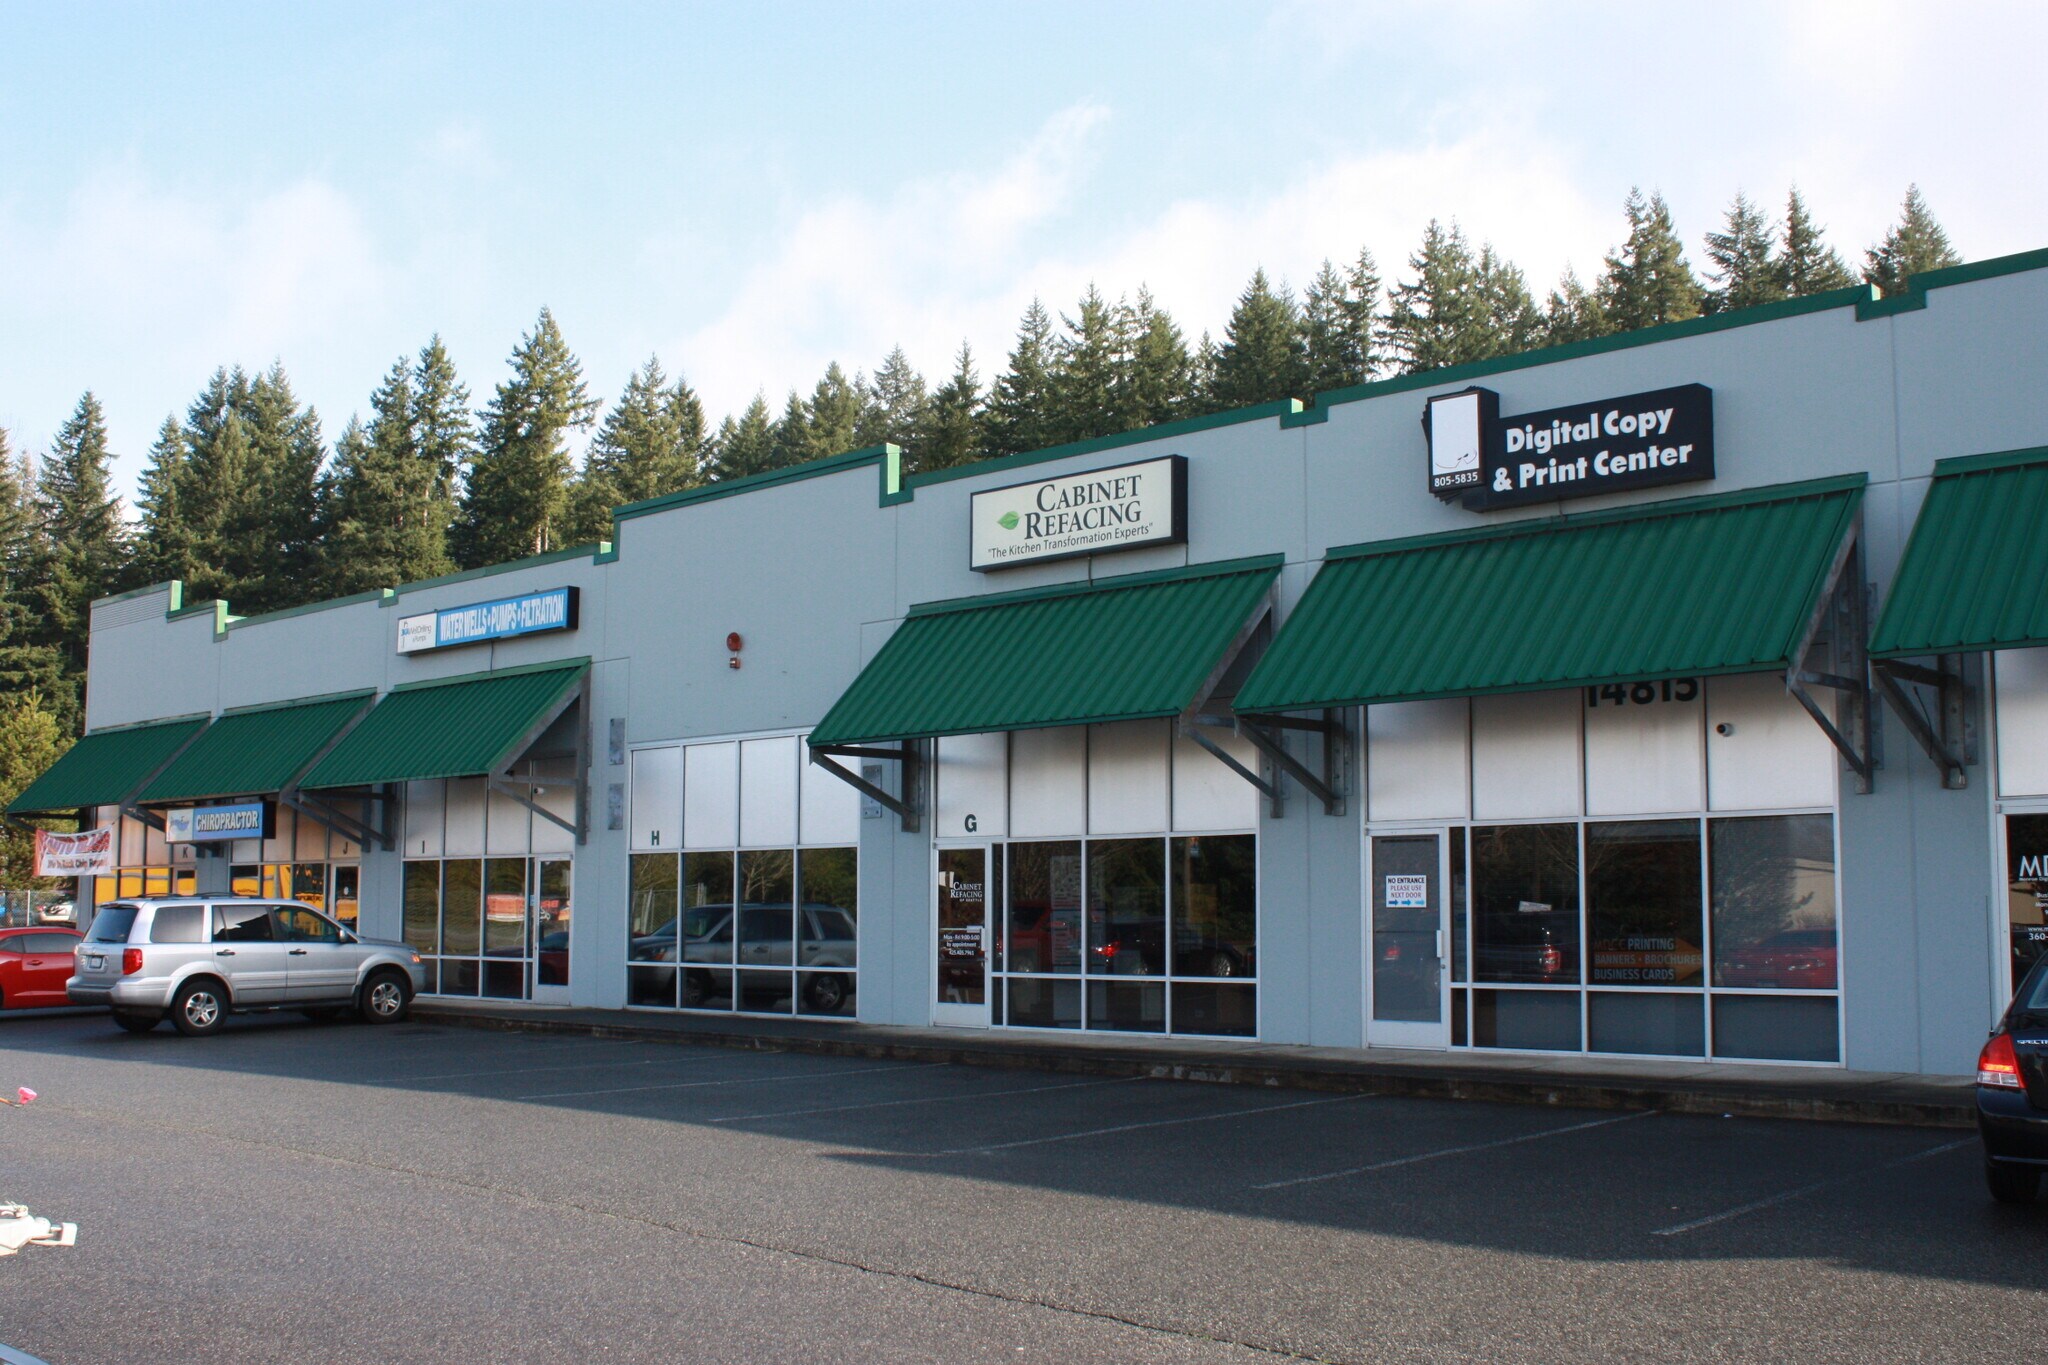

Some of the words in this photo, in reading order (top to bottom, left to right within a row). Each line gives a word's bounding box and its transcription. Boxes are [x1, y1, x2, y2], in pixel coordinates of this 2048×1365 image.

[1506, 413, 1599, 454] Digital
[1603, 407, 1674, 438] Copy
[1493, 467, 1513, 493] &
[1519, 457, 1588, 489] Print
[1593, 444, 1693, 477] Center
[1434, 471, 1478, 488] 805-5835
[1036, 474, 1142, 512] CABINET
[1024, 500, 1141, 540] REFACING
[1008, 540, 1041, 556] Kitchen
[1043, 532, 1112, 551] Transformation
[440, 613, 464, 641] WATER
[463, 608, 487, 637] WELLS
[490, 602, 517, 632] PUMPS
[521, 594, 564, 628] FILTRATION
[196, 810, 259, 832] CHIROPRACTOR
[963, 813, 977, 833] G
[651, 830, 660, 846] H
[182, 847, 189, 859] K
[343, 841, 348, 854] J
[950, 889, 983, 898] REFACING
[953, 881, 982, 891] CABINET
[1627, 938, 1675, 951] PRINTING
[1594, 954, 1636, 965] BANNERS
[1644, 954, 1702, 966] BROCHURES
[1594, 968, 1640, 980] BUSINESS
[1641, 968, 1675, 980] CARDS
